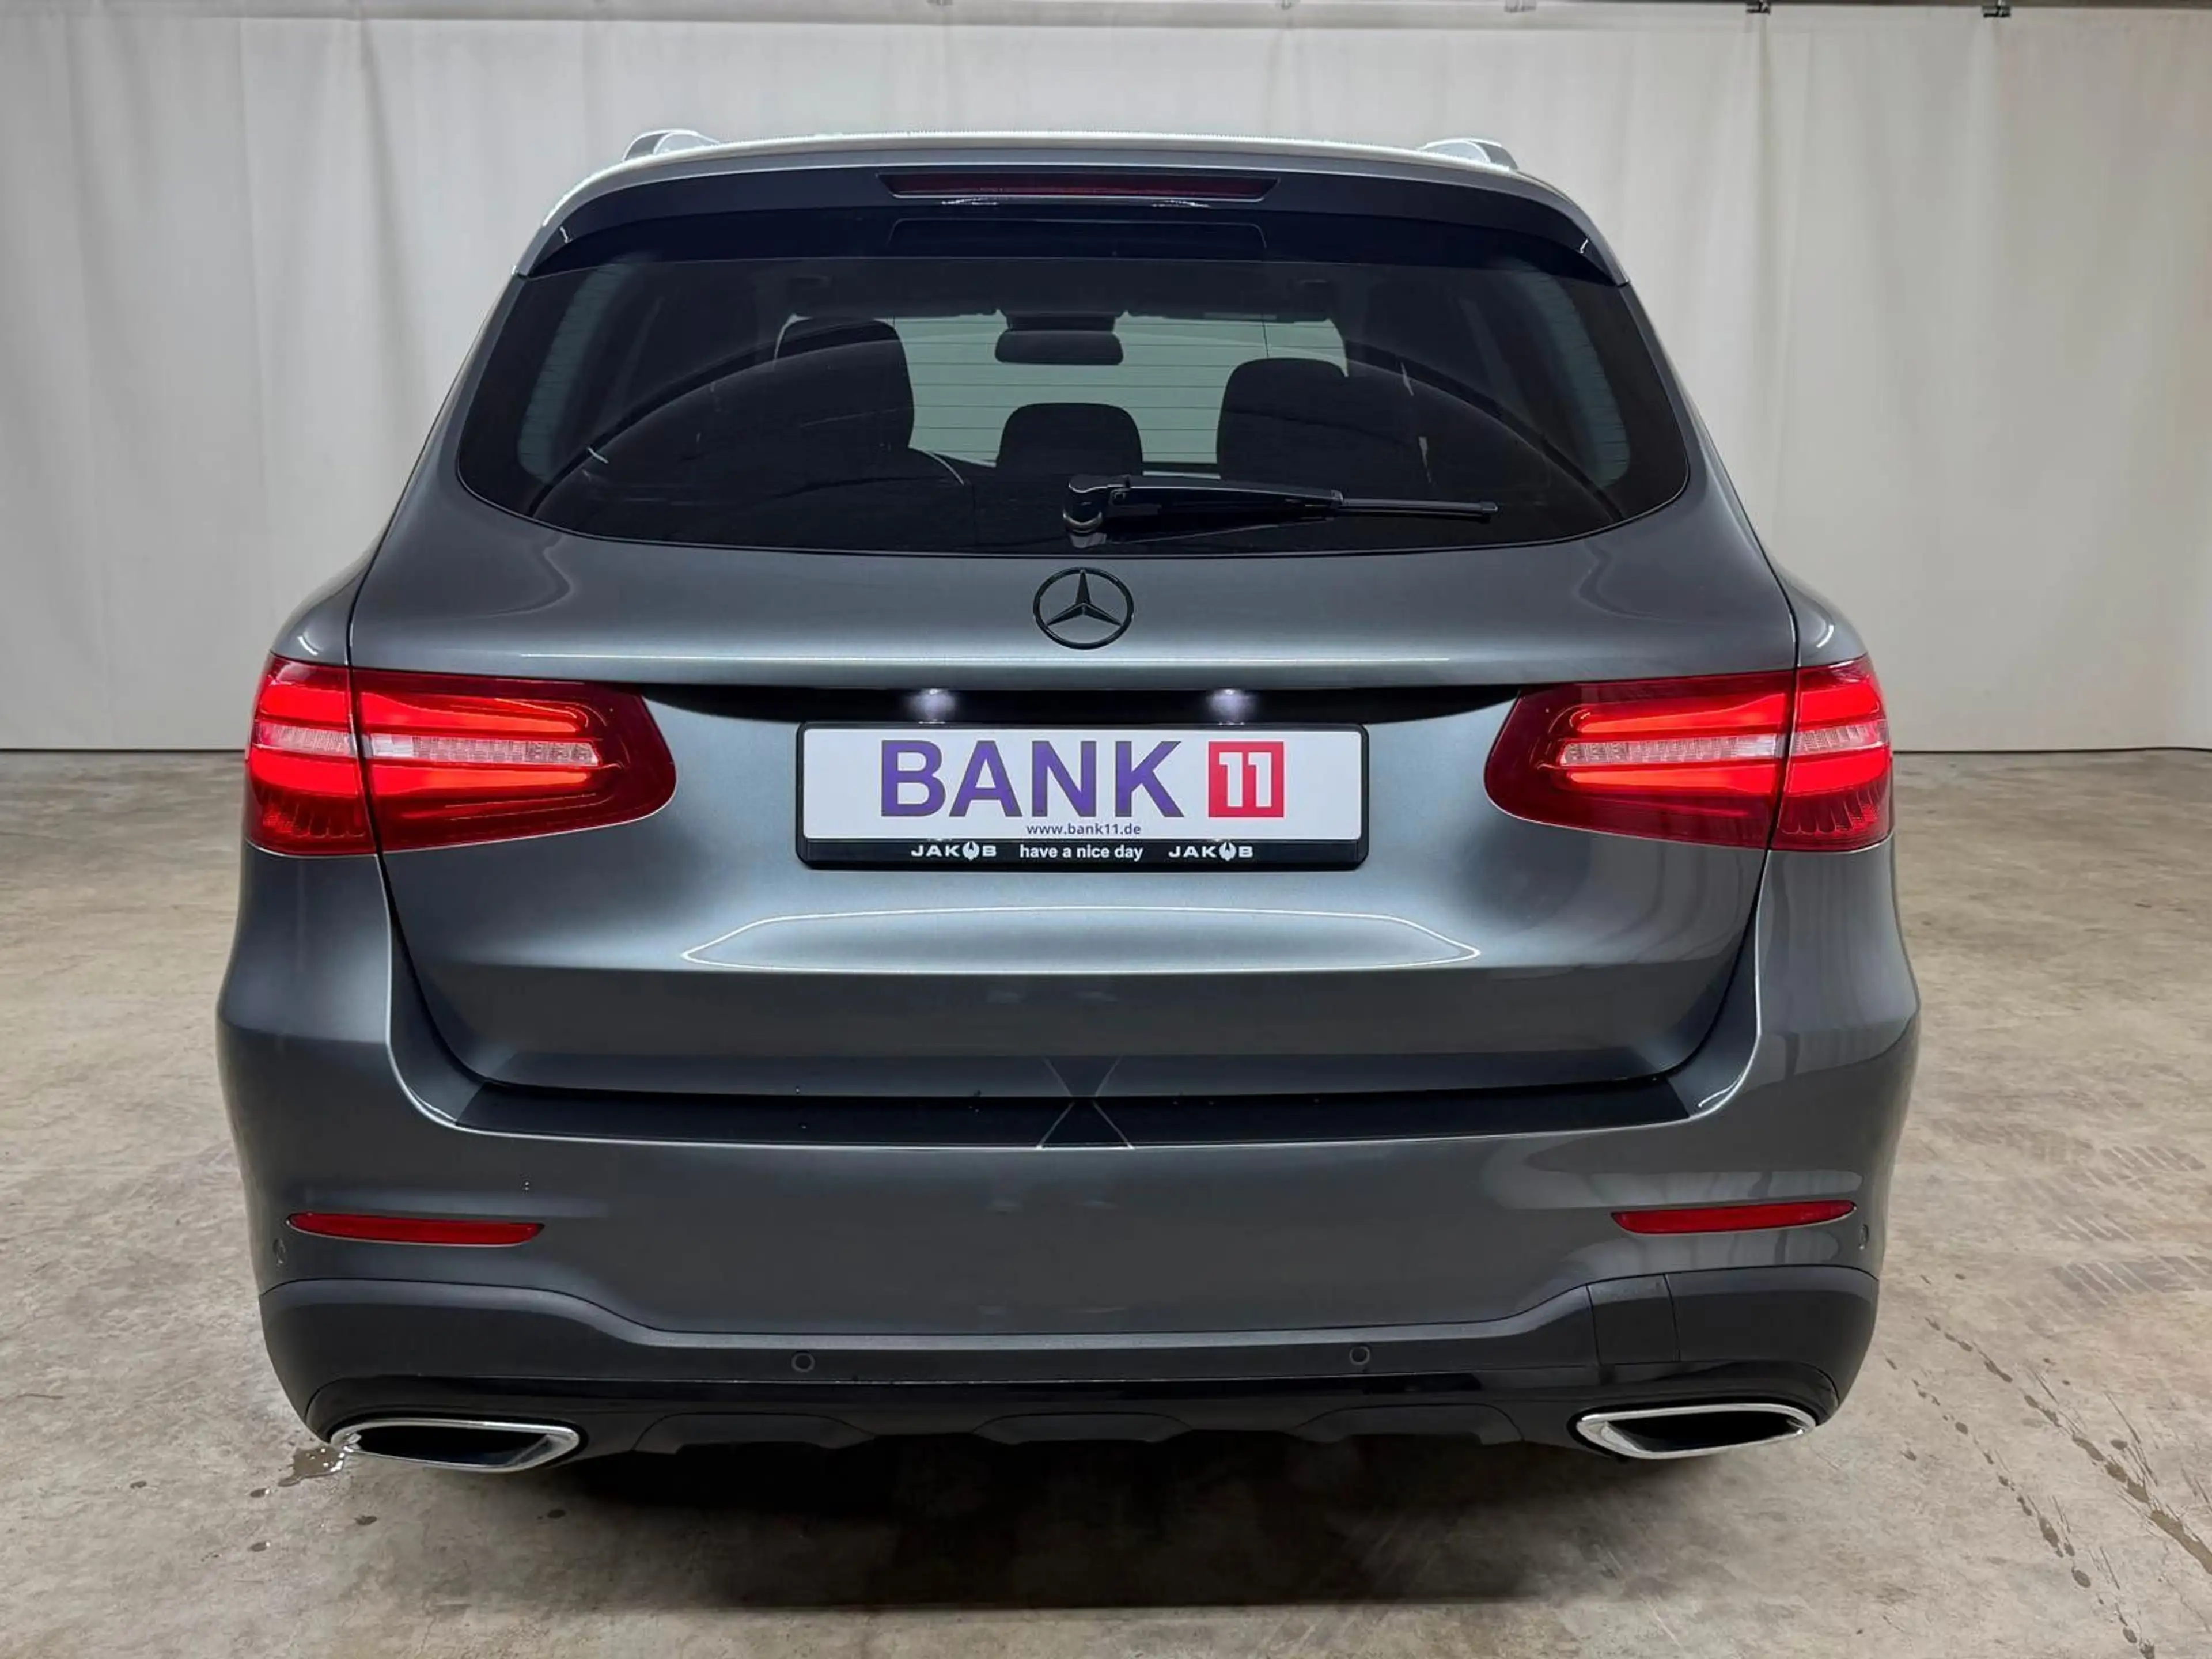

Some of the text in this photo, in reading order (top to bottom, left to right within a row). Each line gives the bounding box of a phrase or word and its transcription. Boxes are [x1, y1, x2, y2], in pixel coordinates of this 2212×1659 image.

[881, 741, 1272, 817] BANK 11
[1027, 822, 1141, 836] www.bank11.de
[1020, 844, 1143, 862] have a nice day
